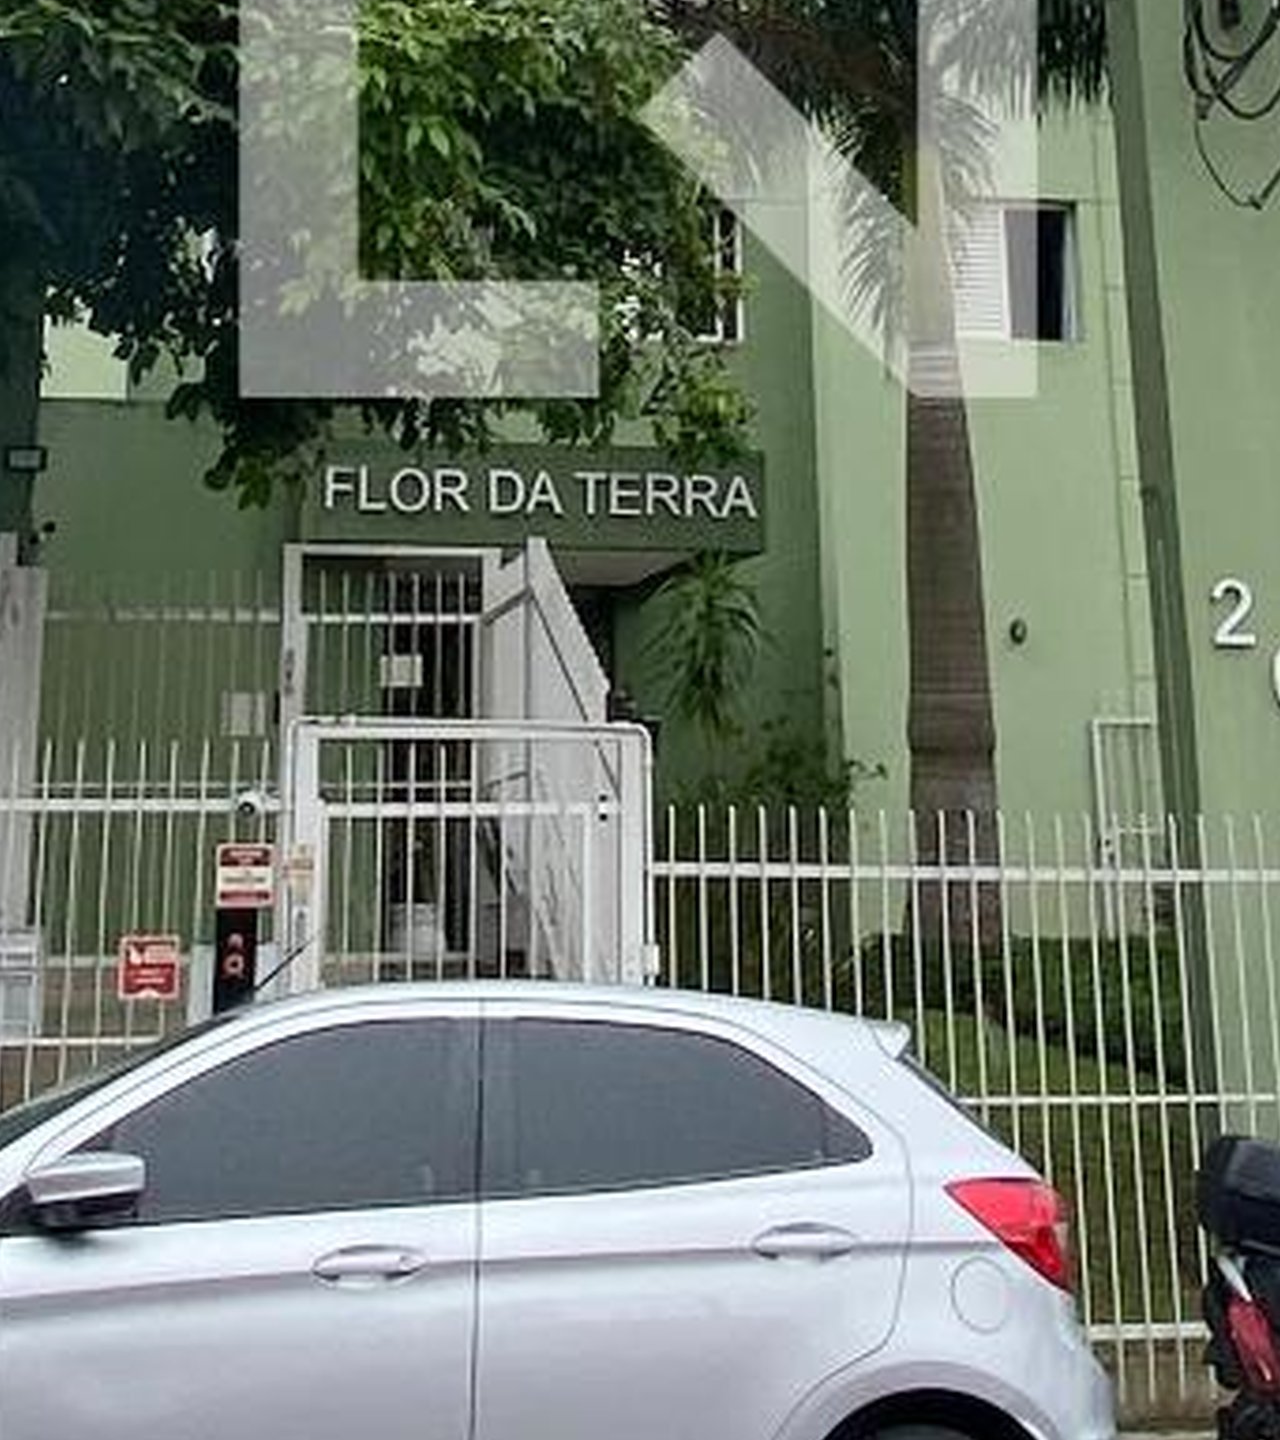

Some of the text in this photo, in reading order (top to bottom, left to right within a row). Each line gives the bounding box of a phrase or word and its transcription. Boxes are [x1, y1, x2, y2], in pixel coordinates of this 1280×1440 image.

[324, 465, 758, 518] FLOR DA TERRA
